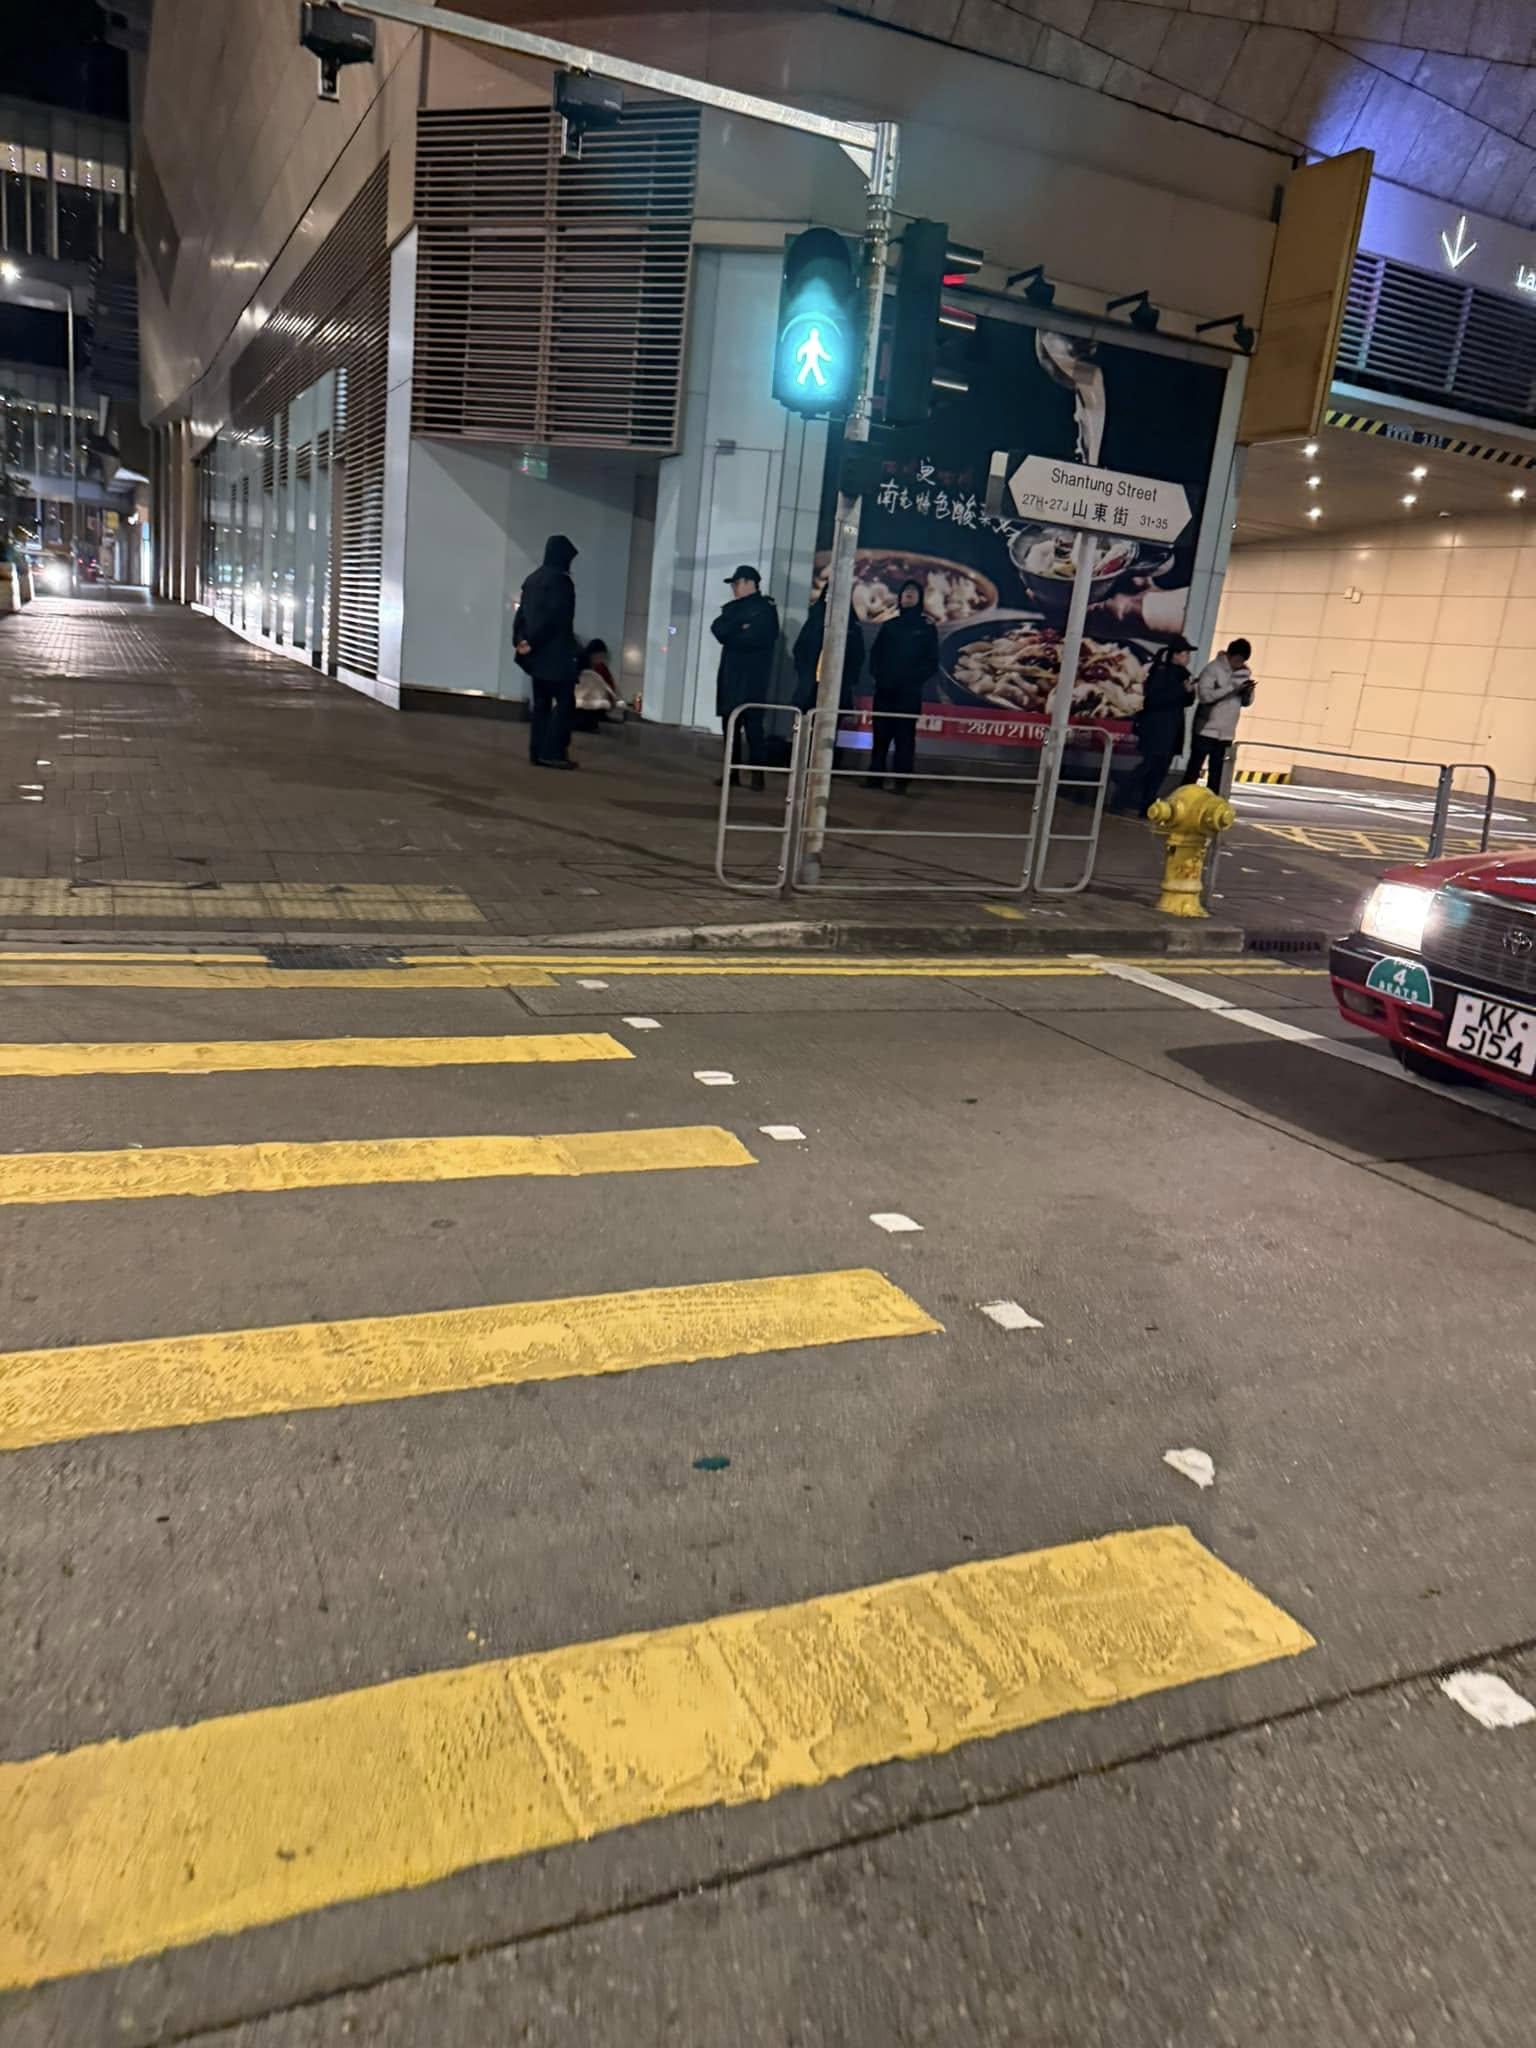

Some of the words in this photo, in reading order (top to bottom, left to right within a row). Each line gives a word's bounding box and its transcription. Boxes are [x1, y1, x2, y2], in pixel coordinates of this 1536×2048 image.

[1051, 467, 1113, 497] Shantung
[1117, 480, 1157, 502] Street
[1072, 499, 1129, 527] 山東街
[1393, 969, 1407, 986] 4
[1479, 1002, 1518, 1038] KK
[1459, 1024, 1524, 1068] 5154
